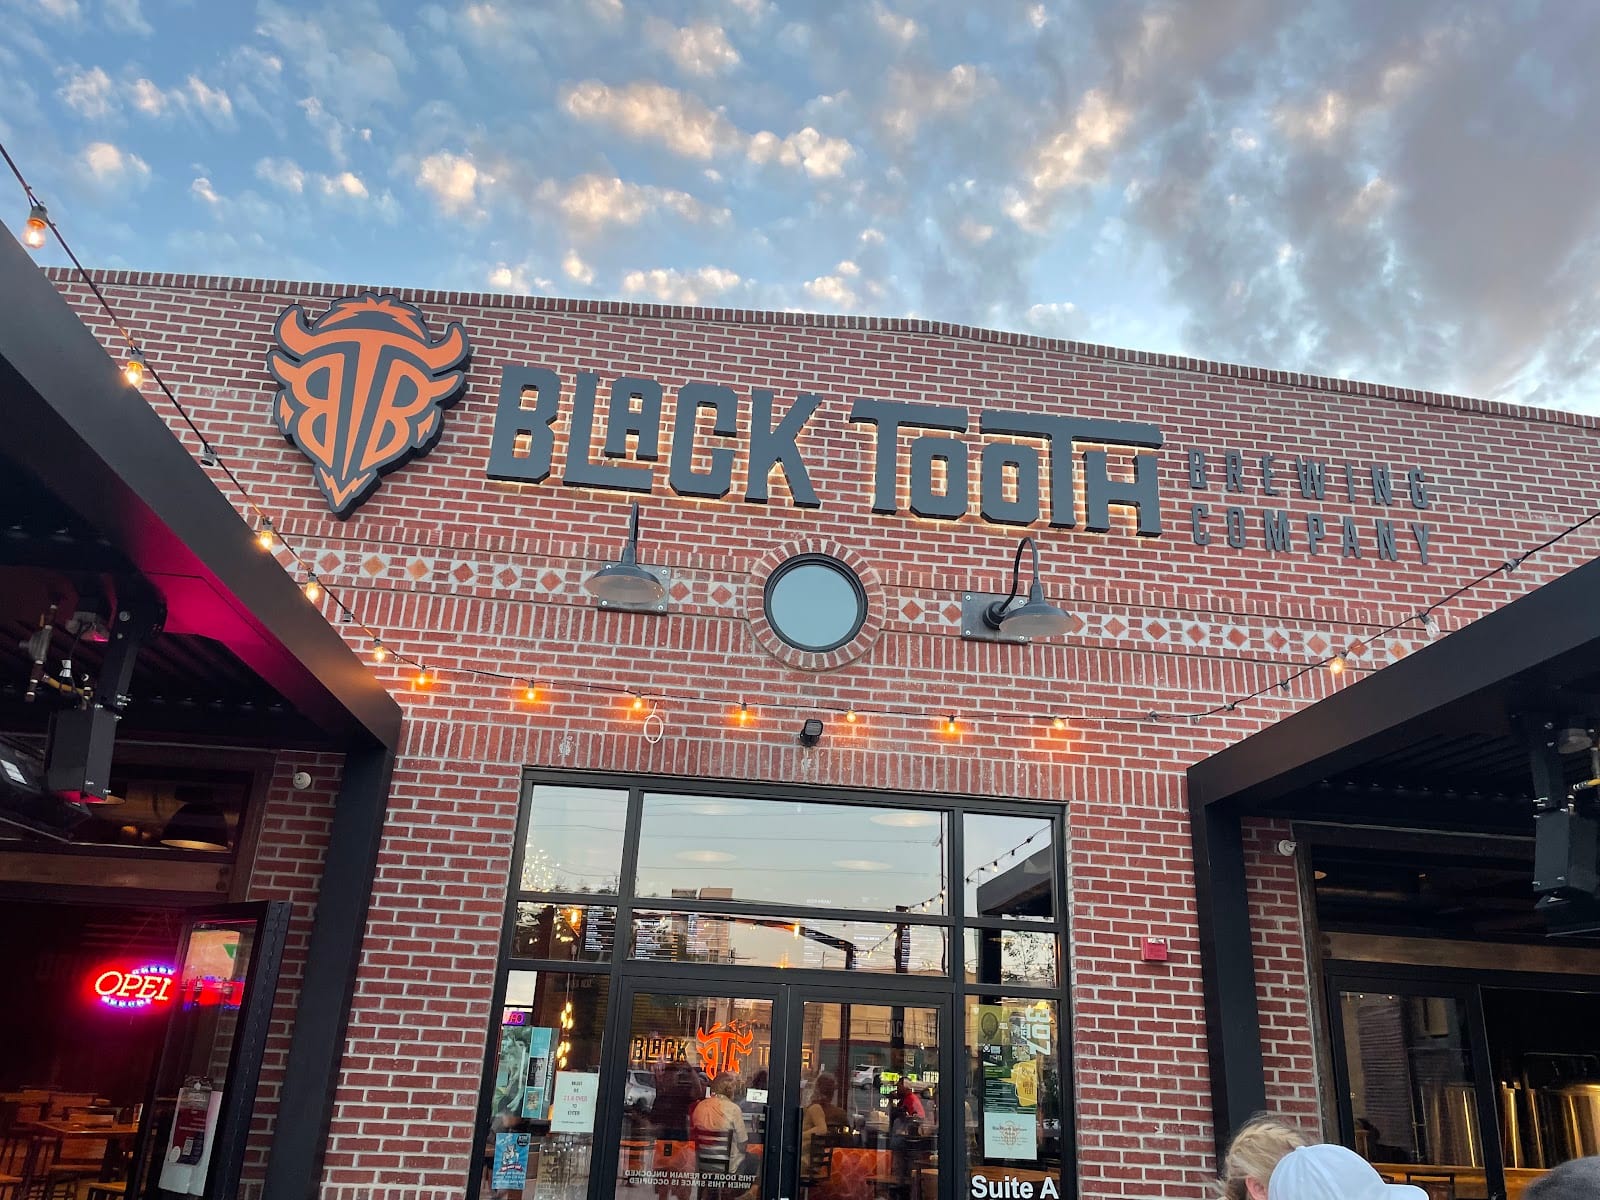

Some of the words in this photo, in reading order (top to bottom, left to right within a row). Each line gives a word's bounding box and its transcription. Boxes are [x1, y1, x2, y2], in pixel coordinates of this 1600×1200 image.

[486, 364, 822, 508] BLACK
[848, 400, 1164, 537] TOOTH
[1188, 447, 1429, 510] BREWING
[1191, 503, 1430, 566] COMPANY
[630, 1037, 690, 1065] BLACK
[971, 1174, 1034, 1199] Suite
[1039, 1176, 1060, 1199] A
